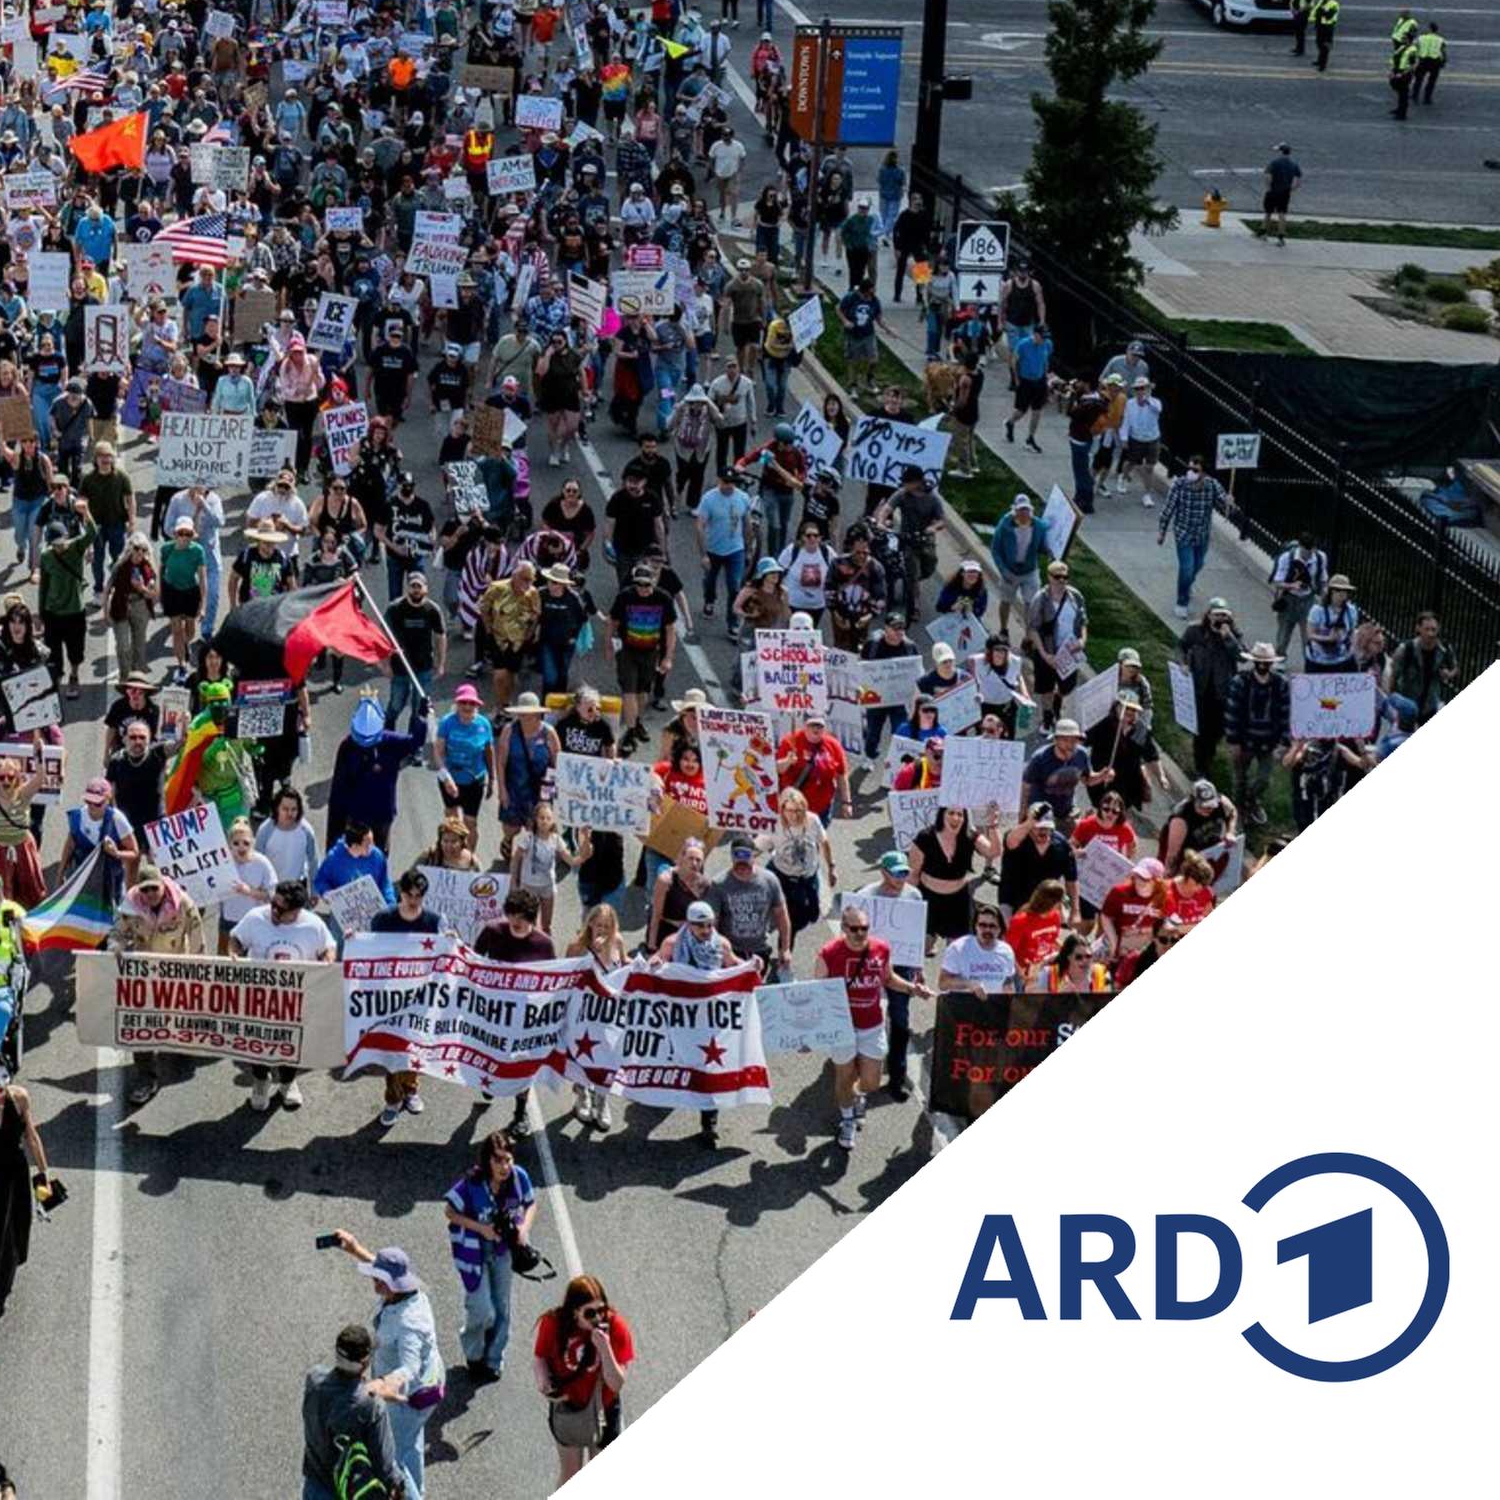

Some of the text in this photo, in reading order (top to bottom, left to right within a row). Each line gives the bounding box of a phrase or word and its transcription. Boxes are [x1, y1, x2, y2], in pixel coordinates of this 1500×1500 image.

[797, 45, 810, 112] DOWNTOWN
[970, 237, 997, 256] 186
[326, 407, 366, 431] PUNKS
[797, 411, 824, 445] NO
[183, 441, 227, 459] NOT
[759, 647, 823, 664] SCHOOLS
[773, 693, 815, 710] WAR
[566, 760, 645, 788] WE ARE
[586, 784, 616, 801] THE
[145, 803, 209, 848] TRUMP
[568, 800, 636, 826] PEOPLE
[715, 810, 779, 832] ICE OUT
[169, 838, 200, 861] IS A
[158, 961, 212, 982] SERVICE
[213, 965, 277, 987] MEMBERS
[278, 970, 307, 990] SAY
[470, 969, 515, 989] PEOPLE
[515, 973, 540, 991] AND
[116, 977, 305, 1023] NO WAR ON IRAN!
[350, 982, 451, 1018] STUDENTS
[455, 986, 517, 1029] FIGHT
[122, 1013, 294, 1042] GET HELP LEAVING THE MILITARY
[707, 1000, 744, 1030] ICE
[120, 1027, 296, 1057] 800-379-2679
[407, 1013, 431, 1035] THE
[433, 1014, 507, 1052] BILLIONAIRE
[955, 1023, 1050, 1047] For our
[951, 1059, 996, 1083] For
